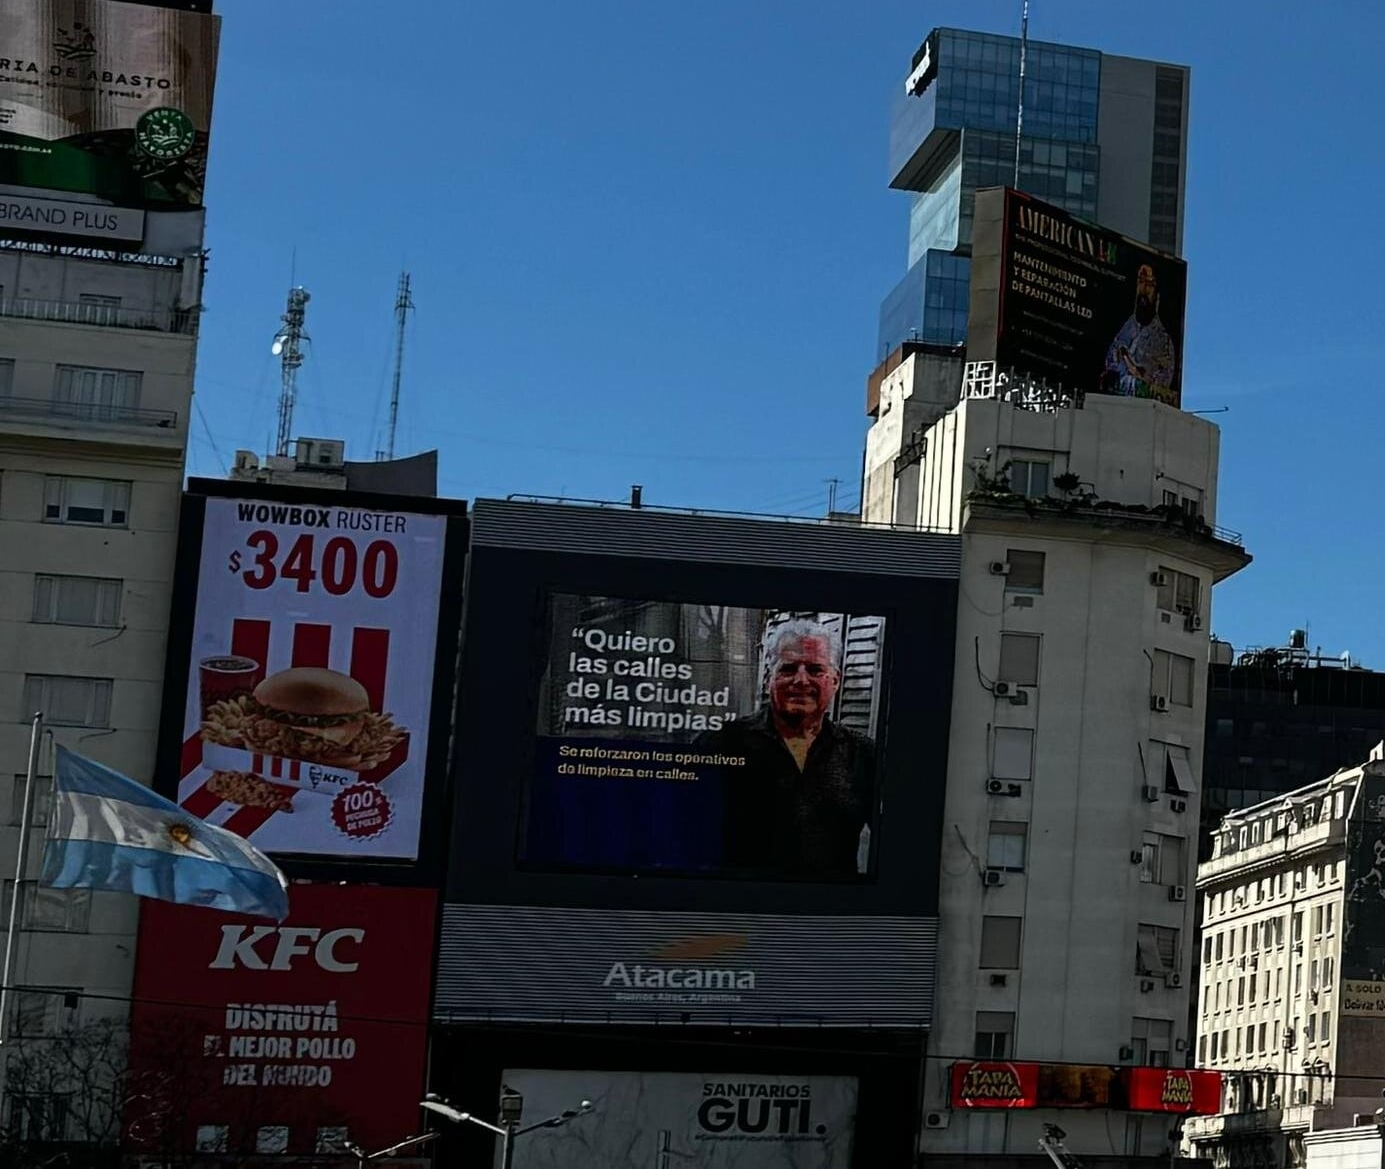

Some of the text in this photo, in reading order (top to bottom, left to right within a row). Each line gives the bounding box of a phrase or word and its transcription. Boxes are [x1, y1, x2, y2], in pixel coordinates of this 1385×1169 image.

[88, 70, 171, 89] ABASTO
[0, 203, 118, 231] BRAND PLUS
[238, 503, 407, 533] WOWBOX RUSTER
[228, 530, 398, 598] $3400
[569, 651, 694, 680] las calles
[566, 676, 731, 707] de la Ciudad
[564, 703, 737, 733] más limpias”
[559, 745, 747, 768] Se reforzaron los operativos
[324, 774, 348, 785] KFC
[557, 762, 576, 775] de
[577, 763, 634, 780] limpieza
[636, 767, 654, 778] en
[207, 924, 366, 973] KFC
[601, 962, 756, 990] Atacama
[225, 999, 338, 1032] DISFRUTÁ
[228, 1035, 291, 1059] MEJOR
[295, 1036, 357, 1060] POLLO
[223, 1063, 257, 1087] DEL
[703, 1083, 811, 1098] SANITARIOS
